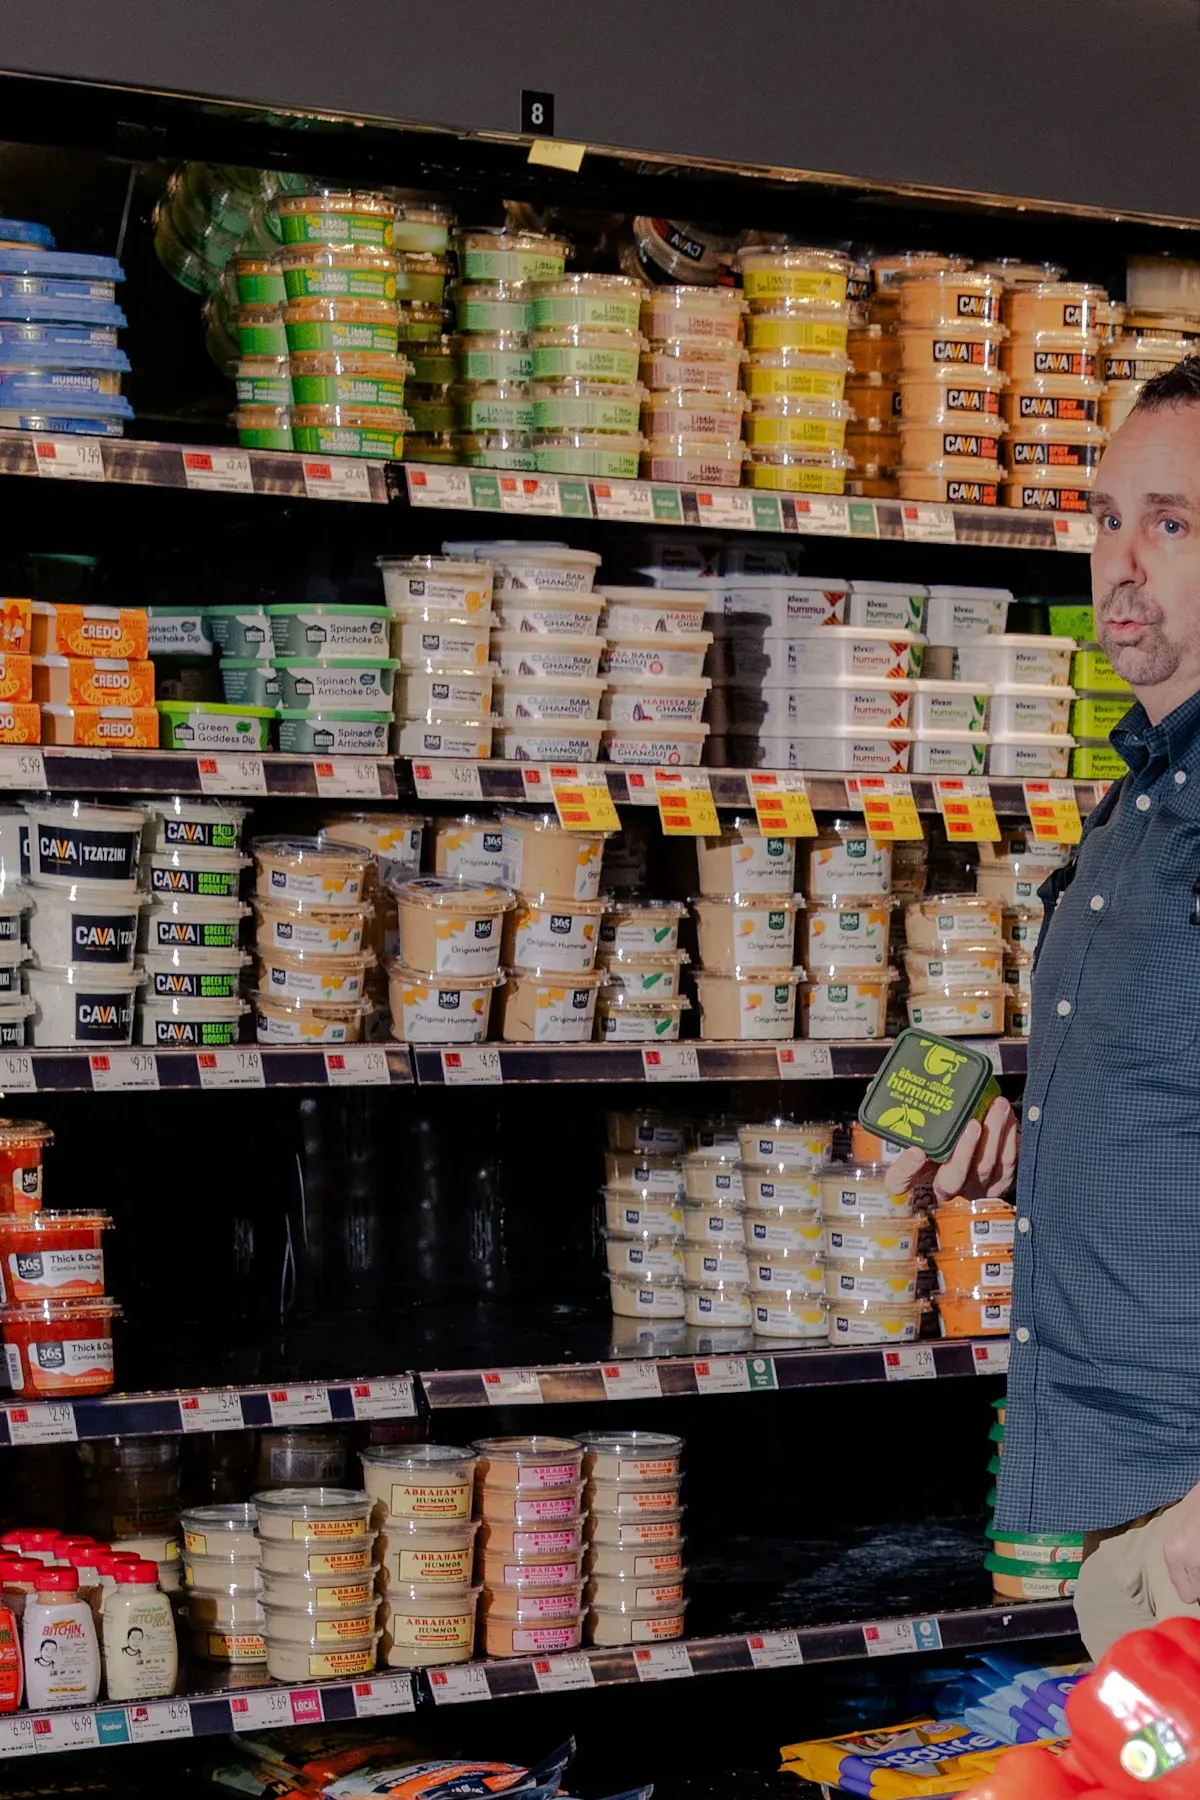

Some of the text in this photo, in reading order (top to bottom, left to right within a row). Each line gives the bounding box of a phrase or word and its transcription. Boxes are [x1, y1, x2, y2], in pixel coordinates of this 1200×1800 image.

[531, 103, 543, 124] 8
[52, 376, 91, 385] HUMMUS
[787, 604, 825, 615] hummus
[866, 609, 903, 621] hummus
[953, 614, 989, 625] hummus
[81, 624, 122, 639] CREDO
[330, 624, 368, 635] Spinach
[330, 635, 370, 645] Artichoke
[69, 638, 109, 658] CASHEW
[853, 655, 891, 666] hummus
[92, 674, 130, 689] CREDO
[316, 677, 356, 687] Spinach
[81, 686, 116, 704] CASHEW
[317, 686, 359, 696] Artichoke
[97, 724, 134, 738] CREDO
[198, 723, 229, 733] Green
[338, 729, 372, 739] Spinach
[198, 732, 256, 745] Goddess Dip
[338, 739, 375, 749] Artichoke
[18, 758, 41, 773] $5.99
[238, 762, 260, 776] $6.99
[168, 822, 204, 840] CAVA
[41, 840, 126, 862] CAVA TZATZIKI
[153, 869, 220, 890] CAVA GREEK
[826, 870, 853, 878] Original
[199, 883, 228, 895] GODDESS
[476, 922, 491, 933] 365
[552, 917, 570, 929] 365
[76, 926, 116, 945] CAVA
[159, 923, 224, 943] CAVA GREEK
[204, 936, 232, 946] GODDESS
[527, 938, 554, 949] Original
[451, 945, 479, 954] Original
[156, 974, 221, 994] CAVA GREEK
[201, 986, 230, 996] GODDESS
[440, 993, 459, 1003] 365
[79, 1004, 117, 1023] CAVA
[416, 1013, 445, 1024] Original
[158, 1022, 222, 1041] CAVA GREEK
[202, 1034, 231, 1044] GODDESS
[131, 1054, 153, 1071] $9.79
[237, 1053, 259, 1068] $7.49
[363, 1054, 385, 1071] $2.99
[480, 1054, 499, 1068] $4.99
[677, 1051, 696, 1066] $2.99
[6, 1057, 28, 1074] $6.79
[887, 1072, 954, 1111] hummus
[23, 1173, 37, 1186] 365
[19, 1258, 40, 1271] 365
[50, 1255, 76, 1263] Thick
[72, 1344, 95, 1352] Thick
[39, 1350, 62, 1361] 365
[915, 1352, 932, 1366] $2.99
[388, 1383, 409, 1398] $5.49
[218, 1395, 239, 1408] $5.49
[49, 1407, 70, 1421] $2.99
[413, 1553, 468, 1561] ABRAHAM'S
[1017, 1550, 1048, 1558] CEDAR'S
[1023, 1583, 1057, 1591] CEDAR'S
[407, 1618, 466, 1626] ABRAHAM'S
[463, 1669, 484, 1683] $7.29
[389, 1679, 409, 1694] $3.99
[266, 1696, 287, 1710] $3.69
[293, 1701, 319, 1713] LOCAL
[168, 1706, 188, 1719] $6.99
[10, 1721, 31, 1737] $6.99
[72, 1716, 91, 1731] $6.99
[862, 1734, 997, 1769] egglife
